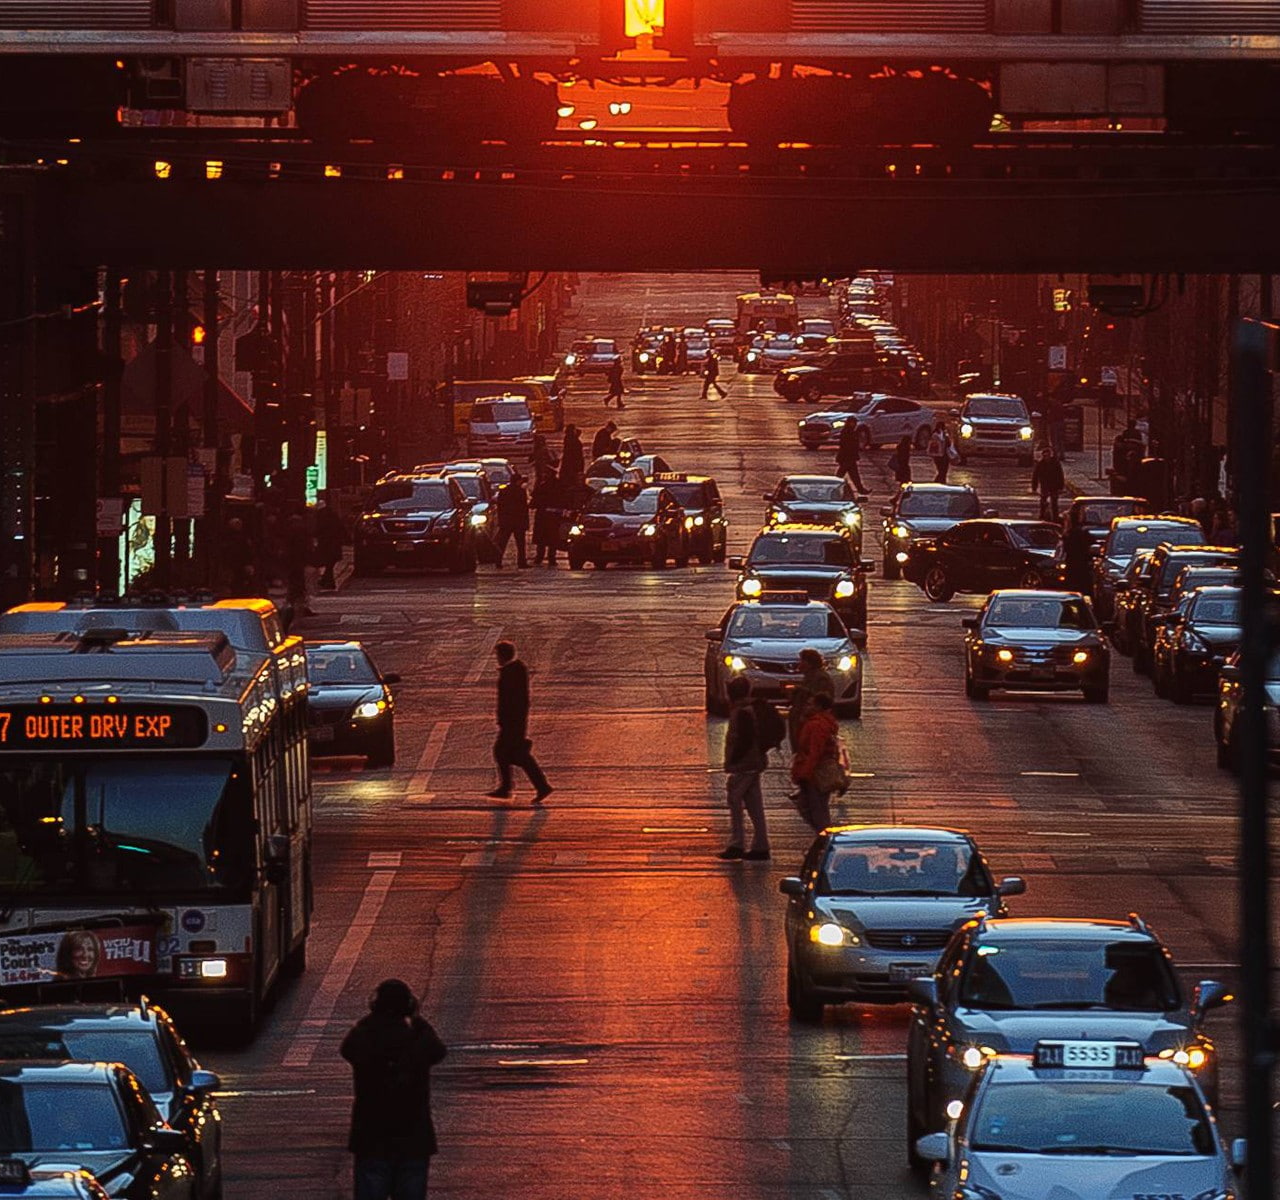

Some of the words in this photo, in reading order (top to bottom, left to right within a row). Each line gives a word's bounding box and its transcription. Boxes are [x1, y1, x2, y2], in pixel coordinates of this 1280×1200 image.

[25, 715, 84, 739] OUTER
[90, 715, 128, 739] DRV
[135, 715, 172, 738] EXP
[0, 940, 56, 957] People's
[0, 954, 39, 970] Court
[1069, 1047, 1110, 1062] 5535
